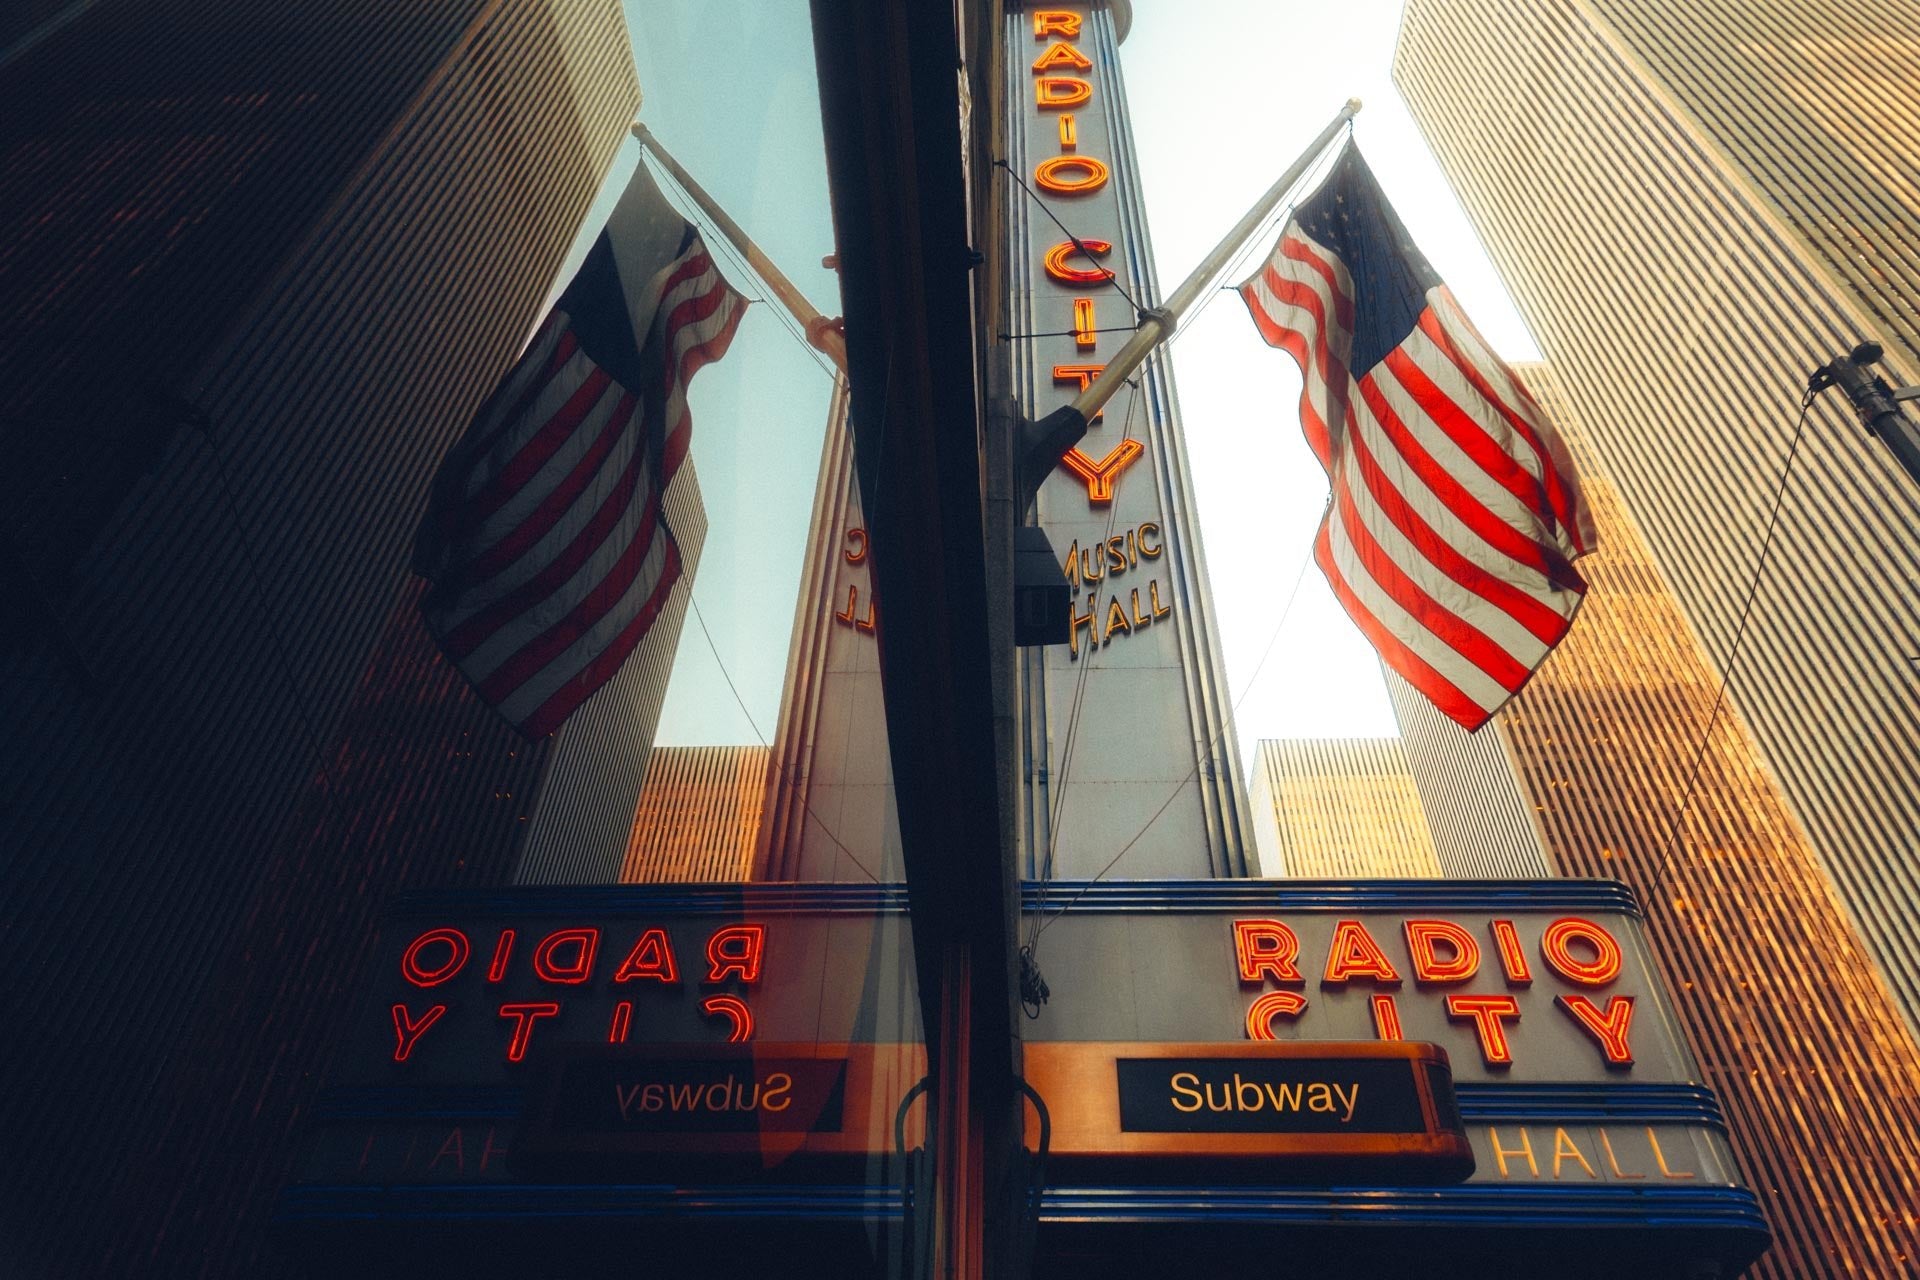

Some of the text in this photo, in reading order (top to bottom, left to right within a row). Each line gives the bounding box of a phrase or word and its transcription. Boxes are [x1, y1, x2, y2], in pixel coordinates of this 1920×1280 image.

[1032, 11, 1110, 196] RADIO
[1069, 579, 1171, 661] HALL
[1231, 917, 1624, 988] RADIO
[1244, 990, 1637, 1070] CITY
[1169, 1070, 1361, 1123] Subway
[1489, 1125, 1695, 1180] HALL
